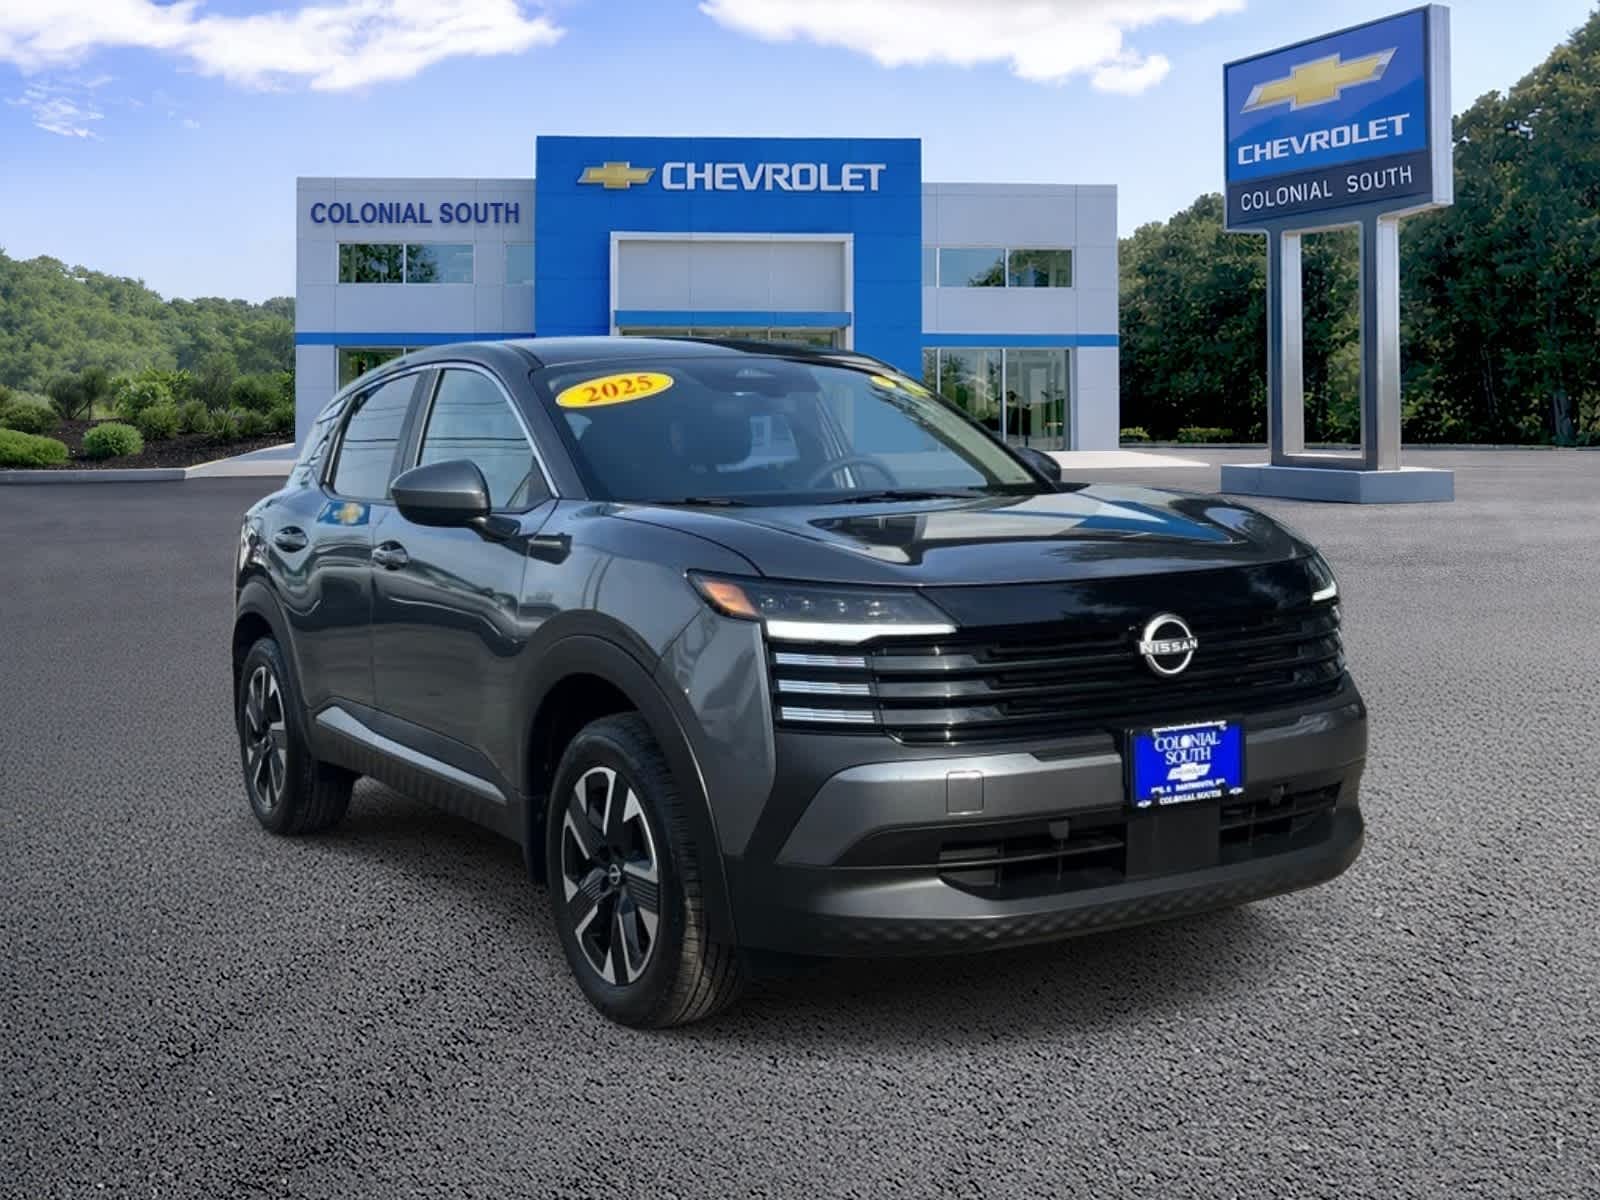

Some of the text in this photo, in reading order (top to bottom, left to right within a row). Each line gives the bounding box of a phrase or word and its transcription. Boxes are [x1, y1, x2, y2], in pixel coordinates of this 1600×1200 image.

[1238, 113, 1410, 165] CHEVROLET
[662, 162, 887, 192] CHEVROLET
[1240, 165, 1413, 212] COLONIAL SOUTH
[310, 202, 520, 225] COLONIAL SOUTH
[583, 375, 653, 402] 2025
[1139, 637, 1198, 655] NISSAN
[1154, 731, 1221, 752] COLONIAL
[1165, 746, 1211, 765] SOUTH
